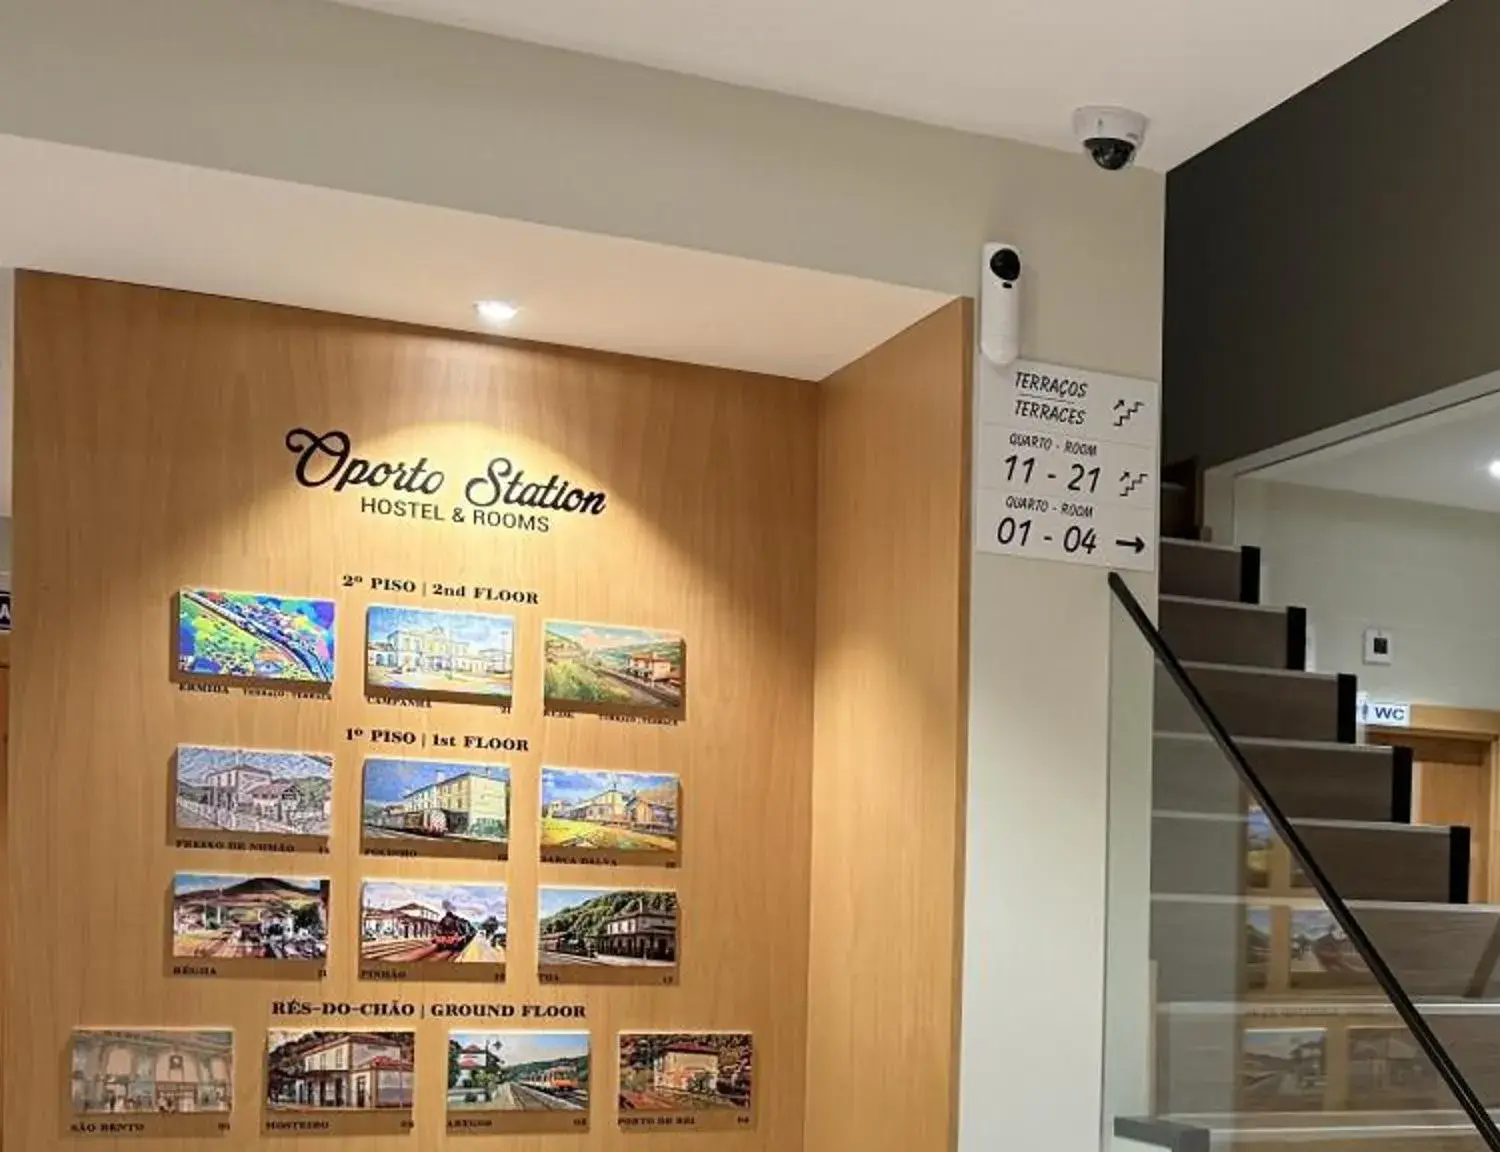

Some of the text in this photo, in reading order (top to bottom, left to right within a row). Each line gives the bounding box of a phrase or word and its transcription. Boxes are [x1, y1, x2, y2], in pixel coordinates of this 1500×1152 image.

[1015, 371, 1088, 398] TERRAÇOS
[1015, 400, 1087, 425] TERRACES
[1009, 432, 1053, 451] QUARTO
[1063, 440, 1098, 457] ROOM
[286, 428, 607, 515] Oporto Station
[1004, 454, 1036, 485] 11
[1067, 463, 1101, 494] 21
[361, 496, 550, 533] HOSTEL & ROOMS
[1005, 495, 1049, 513] QUARTO
[1060, 503, 1094, 518] ROOM
[997, 517, 1032, 547] 01
[1063, 525, 1098, 555] 04
[371, 577, 417, 594] PISO
[432, 583, 466, 599] 2nd
[473, 588, 540, 606] FLOOR
[1374, 706, 1406, 721] WC
[371, 730, 416, 745] PISO
[433, 733, 456, 747] 1st
[464, 735, 530, 752] FLOOR
[431, 1003, 515, 1018] GROUND
[522, 1004, 587, 1018] FLOOR
